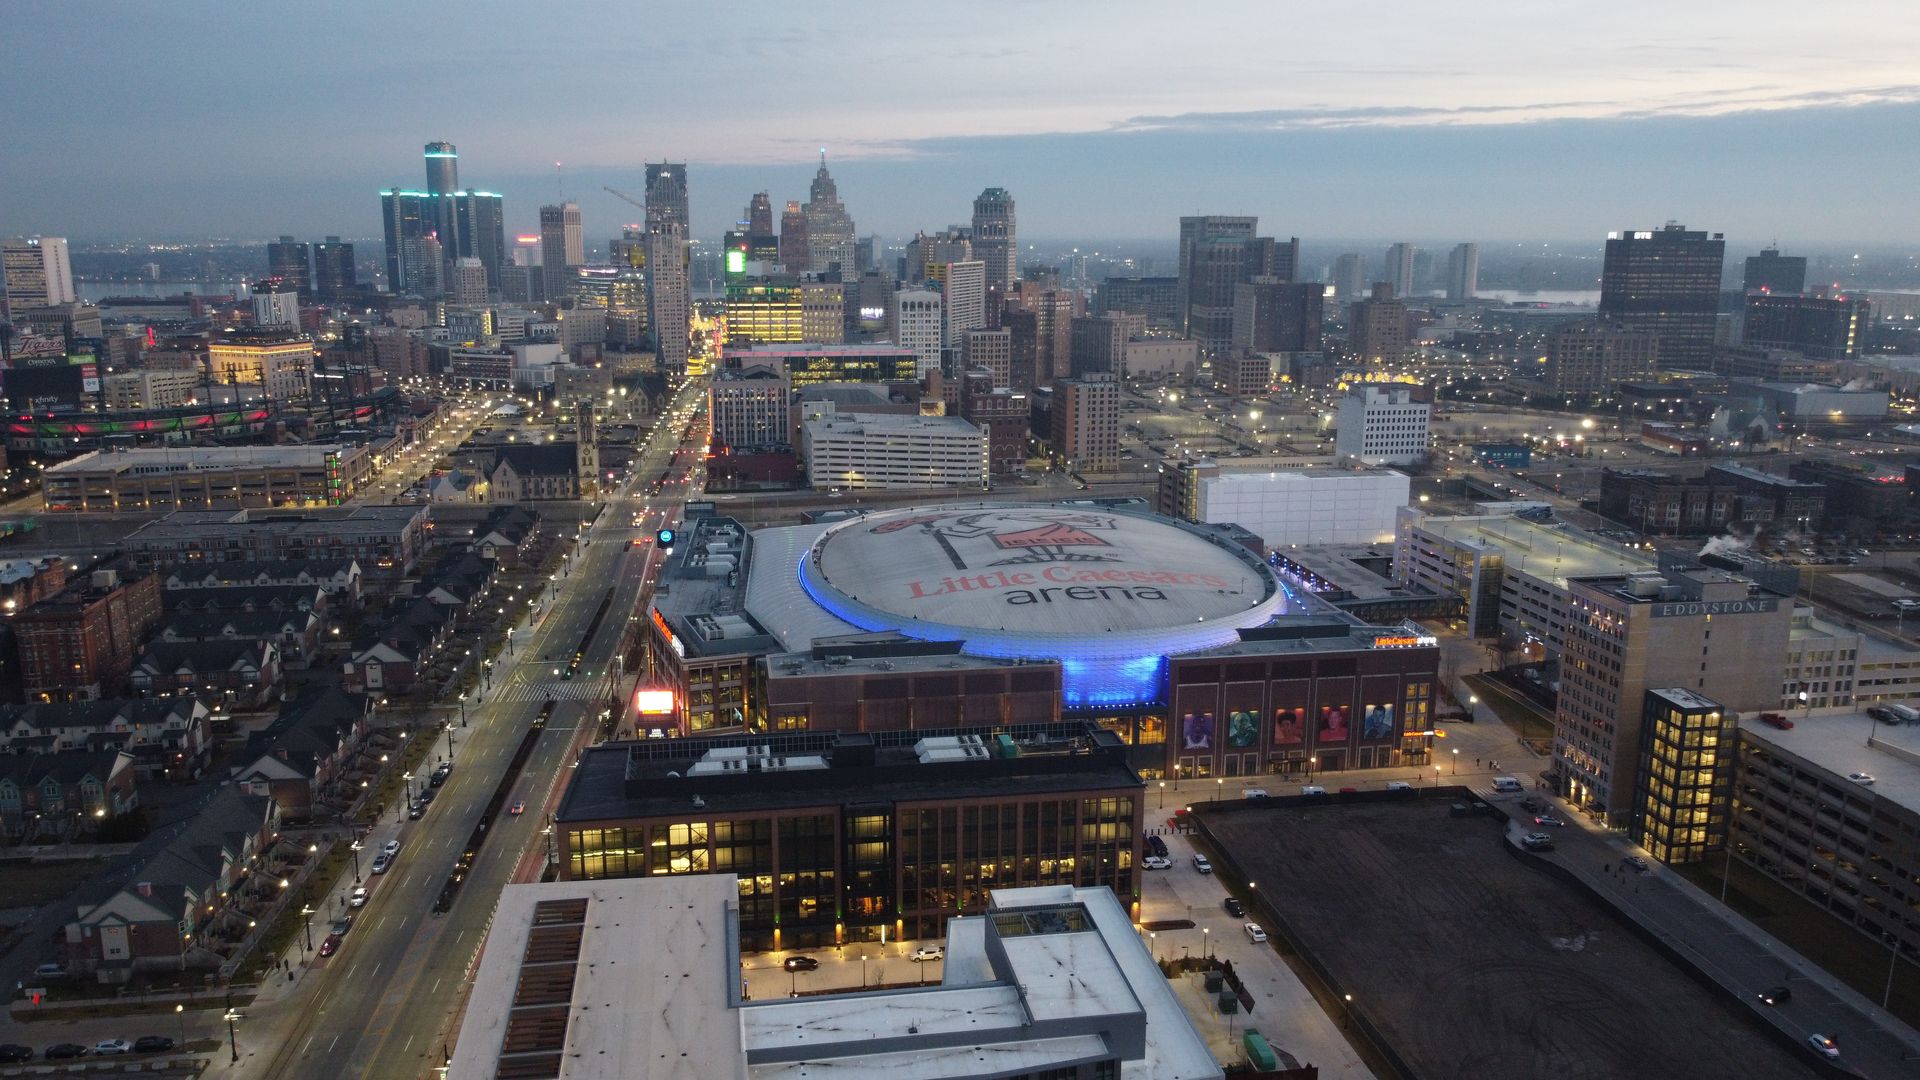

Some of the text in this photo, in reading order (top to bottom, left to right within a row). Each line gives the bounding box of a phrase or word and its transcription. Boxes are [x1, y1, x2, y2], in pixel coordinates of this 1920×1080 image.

[20, 335, 64, 355] Tigers
[904, 565, 1228, 599] Little Caesars
[1003, 586, 1168, 605] arena
[1663, 601, 1768, 616] EDDYSTONE
